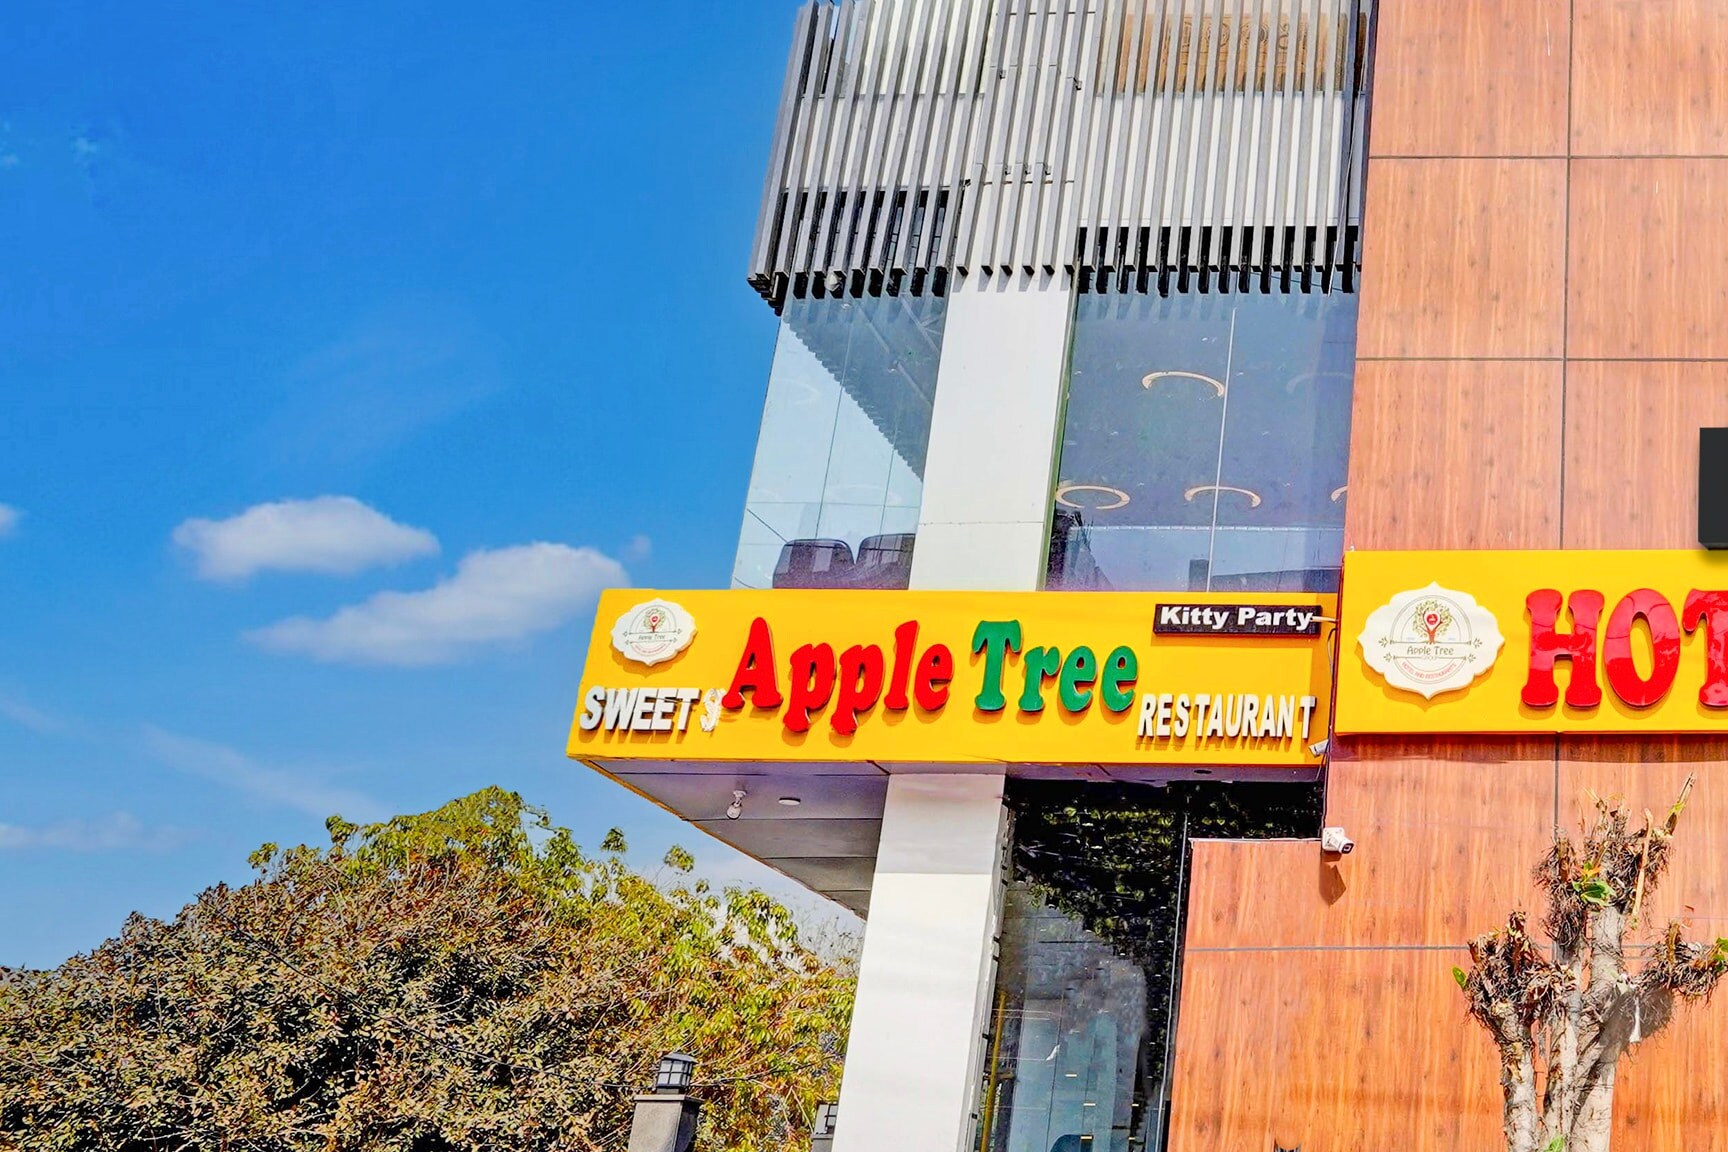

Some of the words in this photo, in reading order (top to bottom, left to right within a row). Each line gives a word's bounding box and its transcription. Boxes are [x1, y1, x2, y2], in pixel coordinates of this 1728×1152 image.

[1160, 606, 1230, 630] Kitty
[1237, 607, 1314, 631] Party
[1407, 646, 1432, 655] Apple
[1434, 646, 1455, 655] Tree
[723, 616, 953, 735] Apple
[970, 619, 1139, 713] Tree
[1137, 692, 1317, 739] RESTAURANT
